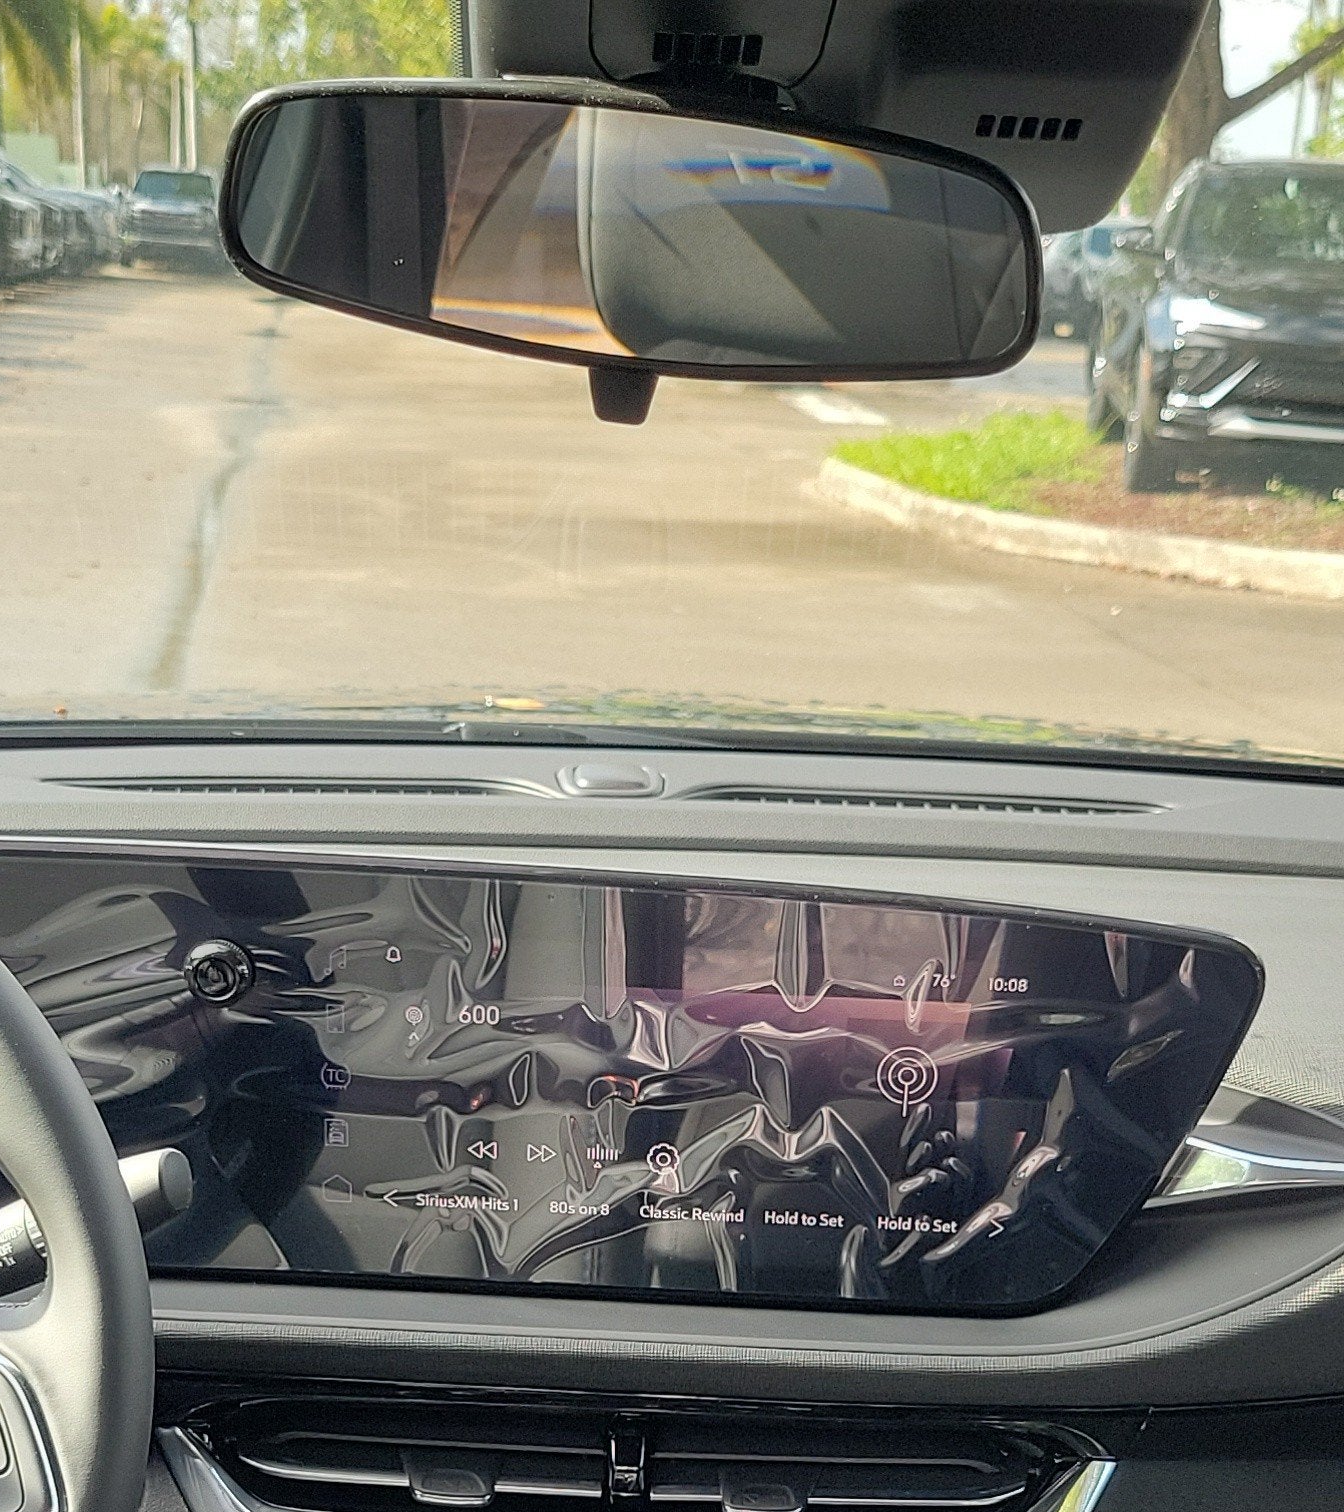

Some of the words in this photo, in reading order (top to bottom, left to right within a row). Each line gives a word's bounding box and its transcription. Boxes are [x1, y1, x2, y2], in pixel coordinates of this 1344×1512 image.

[988, 977, 1028, 993] 10:08
[458, 1004, 500, 1025] 600
[416, 1193, 479, 1210] SiriusXM
[482, 1196, 510, 1211] Hits
[549, 1201, 575, 1215] 80s
[579, 1204, 598, 1216] on
[601, 1204, 610, 1216] 8
[639, 1205, 689, 1221] Classic
[692, 1207, 745, 1223] Rewind
[764, 1210, 798, 1226] Hold
[801, 1213, 816, 1227] to
[819, 1213, 844, 1228] Set
[877, 1216, 912, 1232] Hold
[915, 1218, 930, 1232] to
[932, 1218, 957, 1234] Set
